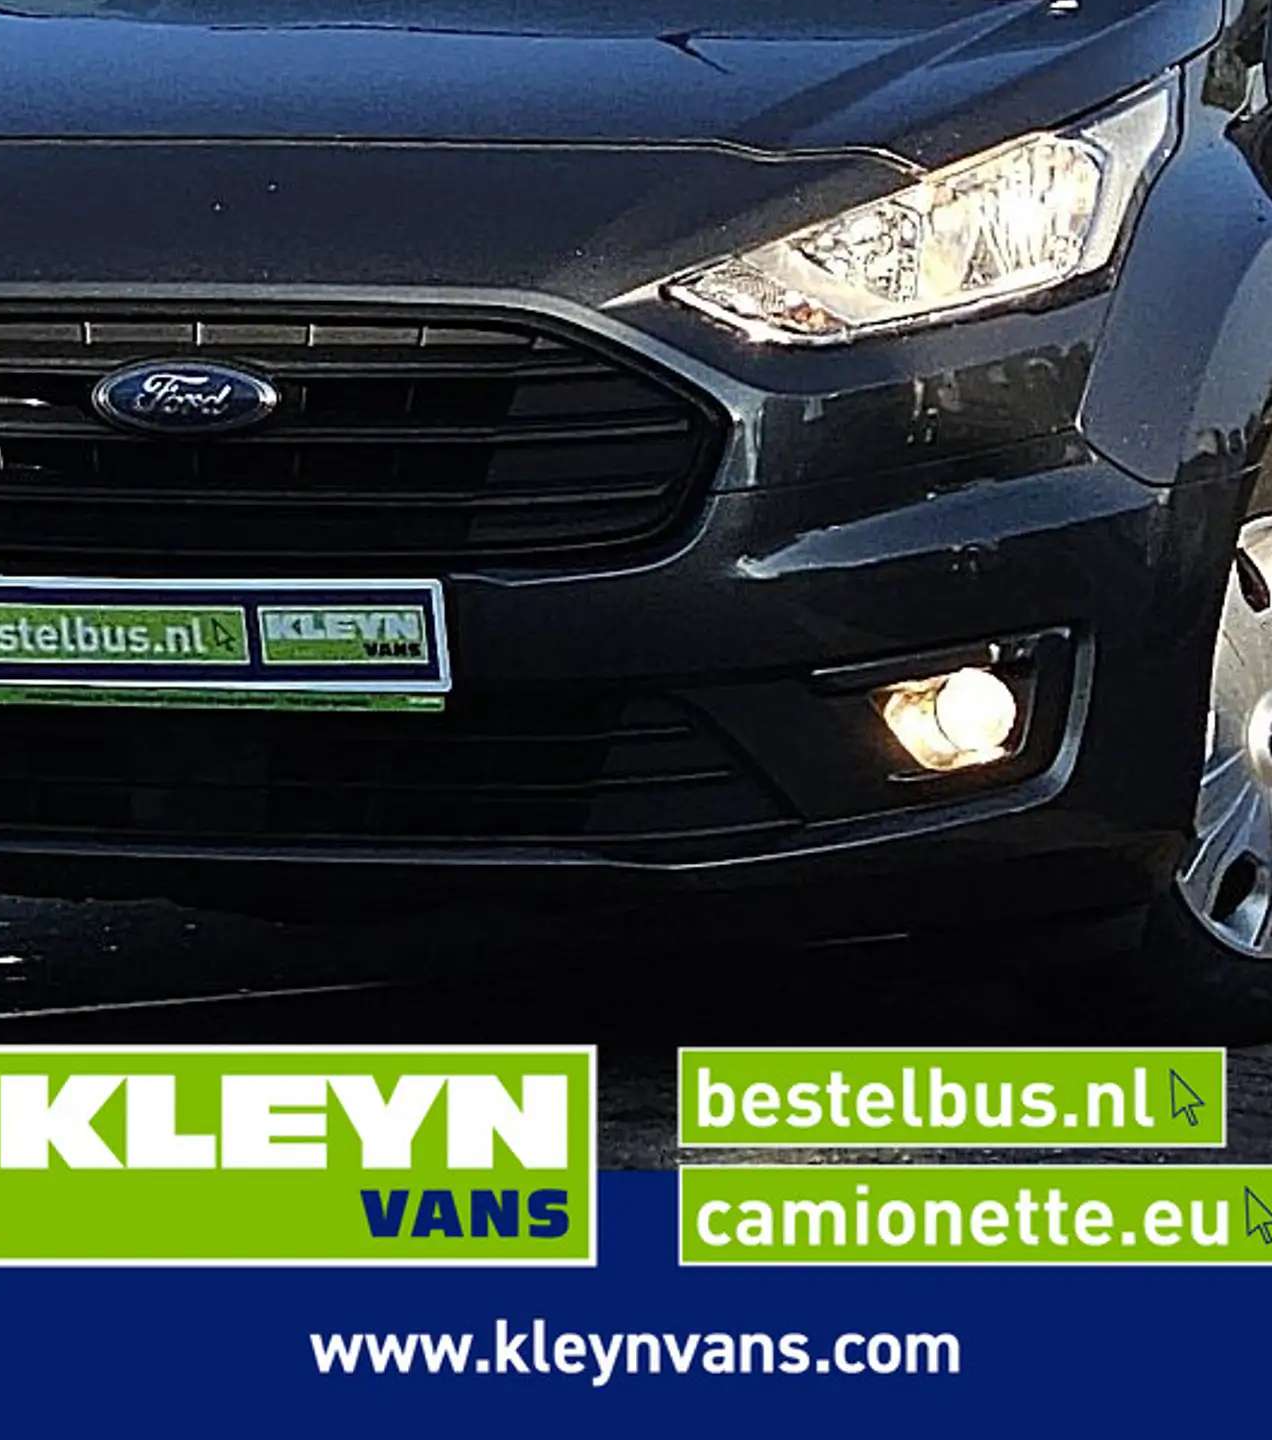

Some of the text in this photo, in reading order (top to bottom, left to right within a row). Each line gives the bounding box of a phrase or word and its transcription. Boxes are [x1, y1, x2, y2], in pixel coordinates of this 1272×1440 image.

[132, 372, 232, 415] Ford
[265, 612, 421, 640] KLEYN
[363, 641, 422, 658] VANS
